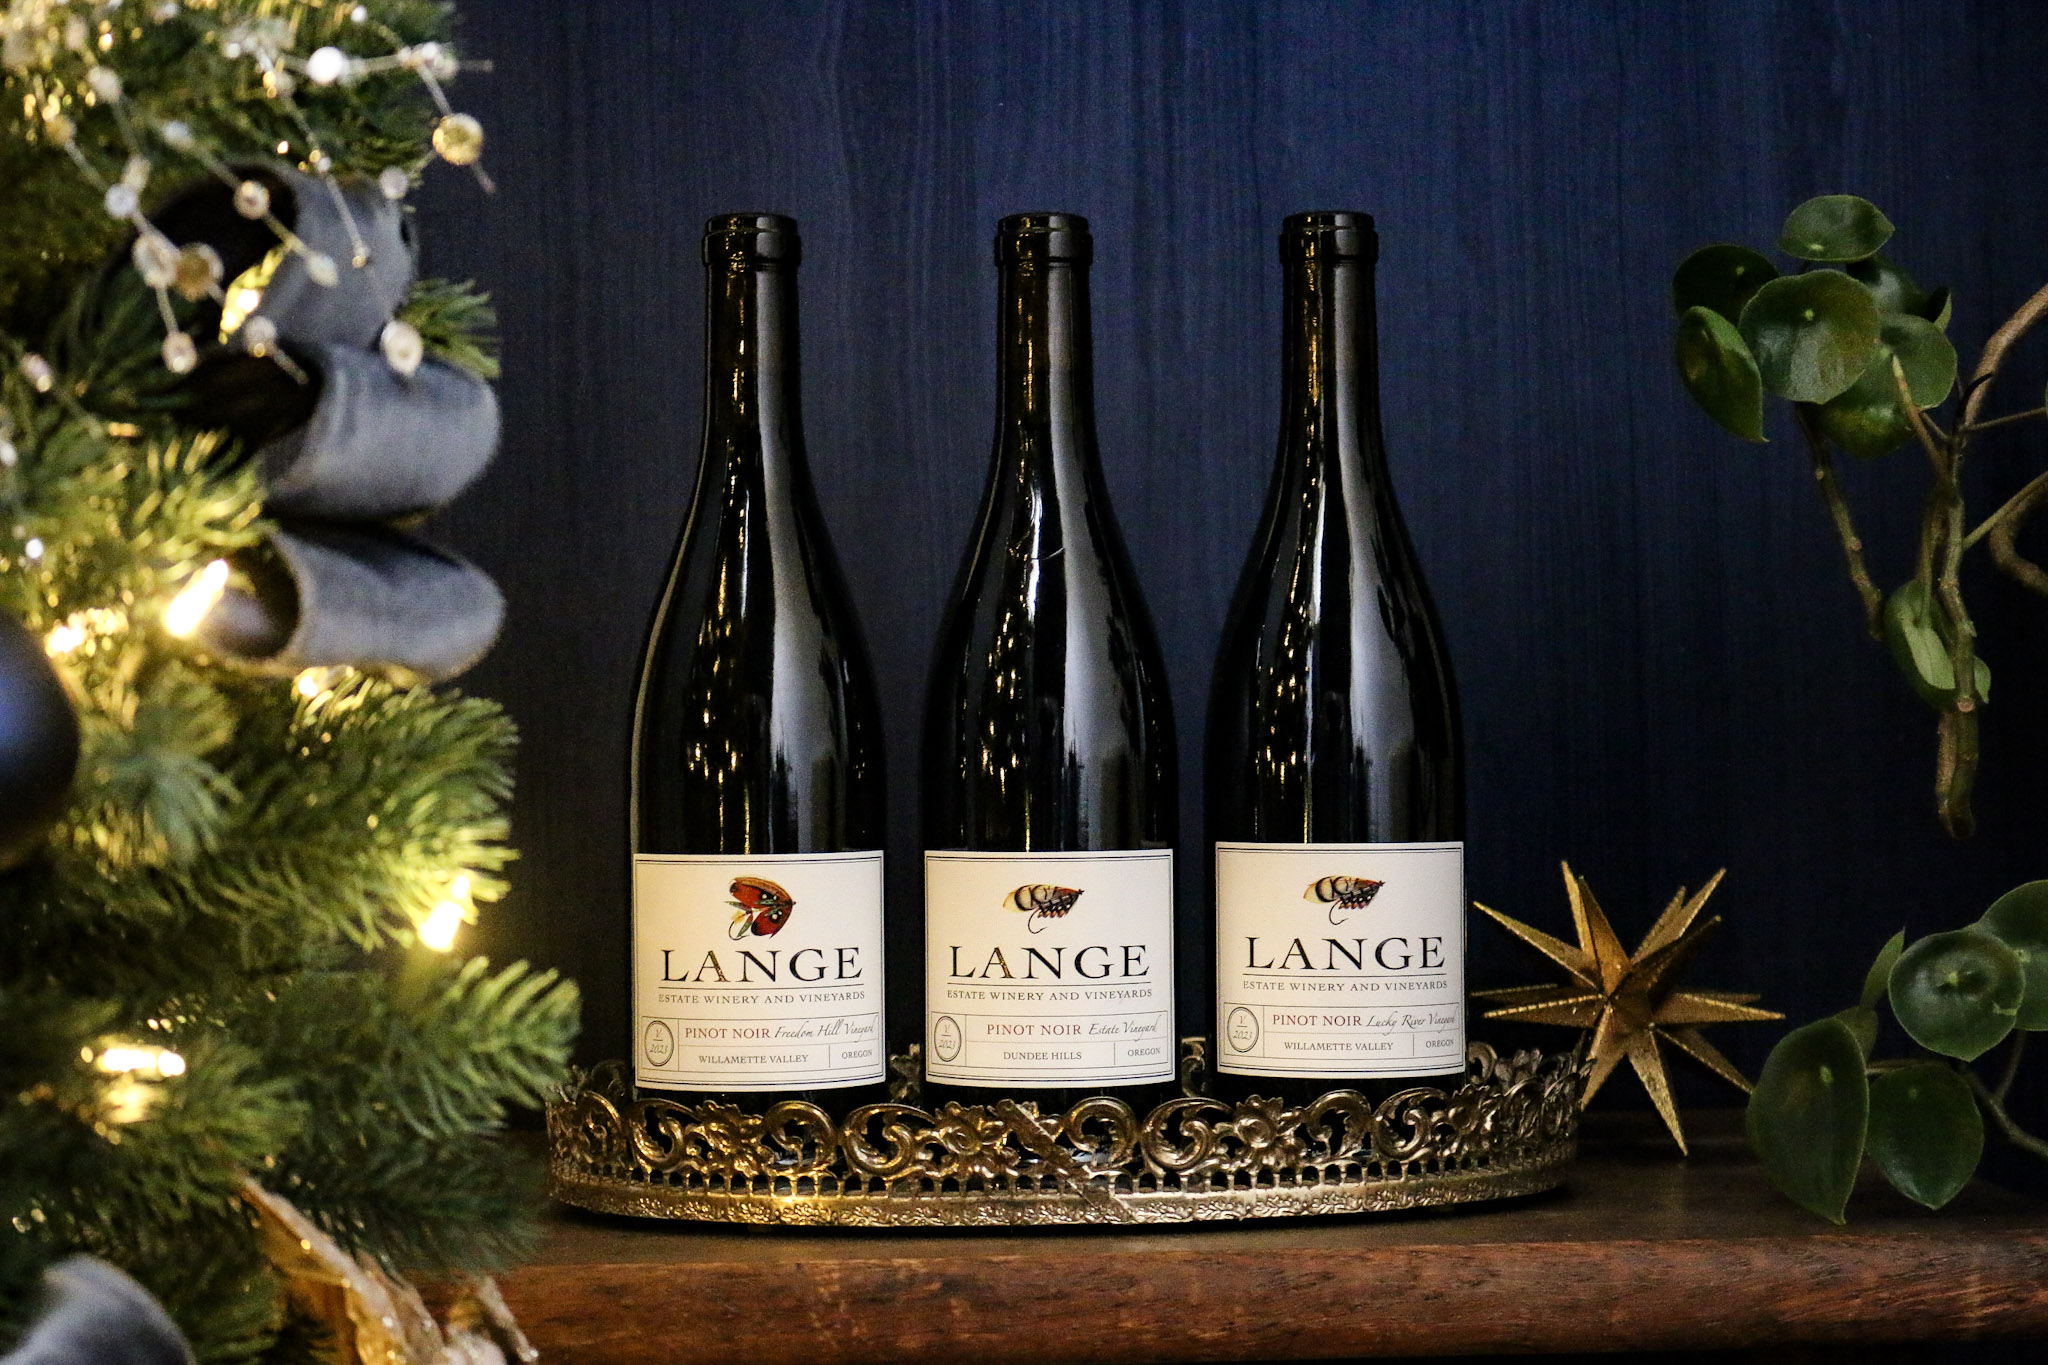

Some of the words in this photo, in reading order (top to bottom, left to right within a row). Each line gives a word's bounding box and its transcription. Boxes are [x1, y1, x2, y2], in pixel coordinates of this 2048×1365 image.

[1244, 936, 1446, 971] LANGE
[660, 946, 863, 983] LANGE
[948, 944, 1151, 980] LANGE
[1242, 980, 1286, 991] ESTATE
[1290, 982, 1346, 992] WINERY
[1350, 982, 1381, 992] AND
[1385, 980, 1448, 991] VINEYARDS
[658, 993, 699, 1004] ESTATE
[704, 995, 757, 1005] WINERY
[764, 994, 795, 1004] AND
[799, 990, 866, 1003] VINEYARDS
[947, 989, 986, 1000] ESTATE
[990, 991, 1045, 1001] WINERY
[1049, 990, 1080, 1001] AND
[1084, 988, 1153, 1000] VINEYARDS
[684, 1028, 728, 1039] PINOT
[732, 1027, 771, 1039] NOIR
[774, 1021, 814, 1038] Freedom
[816, 1019, 842, 1037] Hill
[844, 1014, 876, 1043] Vineyard
[986, 1024, 1035, 1036] PINOT
[1040, 1024, 1082, 1036] NOIR
[1087, 1022, 1120, 1036] Estate
[1121, 1014, 1161, 1042] Vineyard
[1272, 1014, 1318, 1026] PINOT
[1322, 1014, 1362, 1027] NOIR
[1365, 1010, 1398, 1036] Lucky
[1400, 1014, 1427, 1028] River
[1283, 1041, 1353, 1051] WILLAMETTE
[1355, 1041, 1394, 1051] VALLEY
[1425, 1038, 1454, 1049] OREGON
[841, 1049, 873, 1060] OREGON
[1002, 1051, 1049, 1060] DUNDEE
[1051, 1051, 1083, 1060] HILLS
[1127, 1046, 1161, 1057] OREGON
[698, 1055, 769, 1064] WILLAMETTE
[770, 1054, 809, 1064] VALLEY
